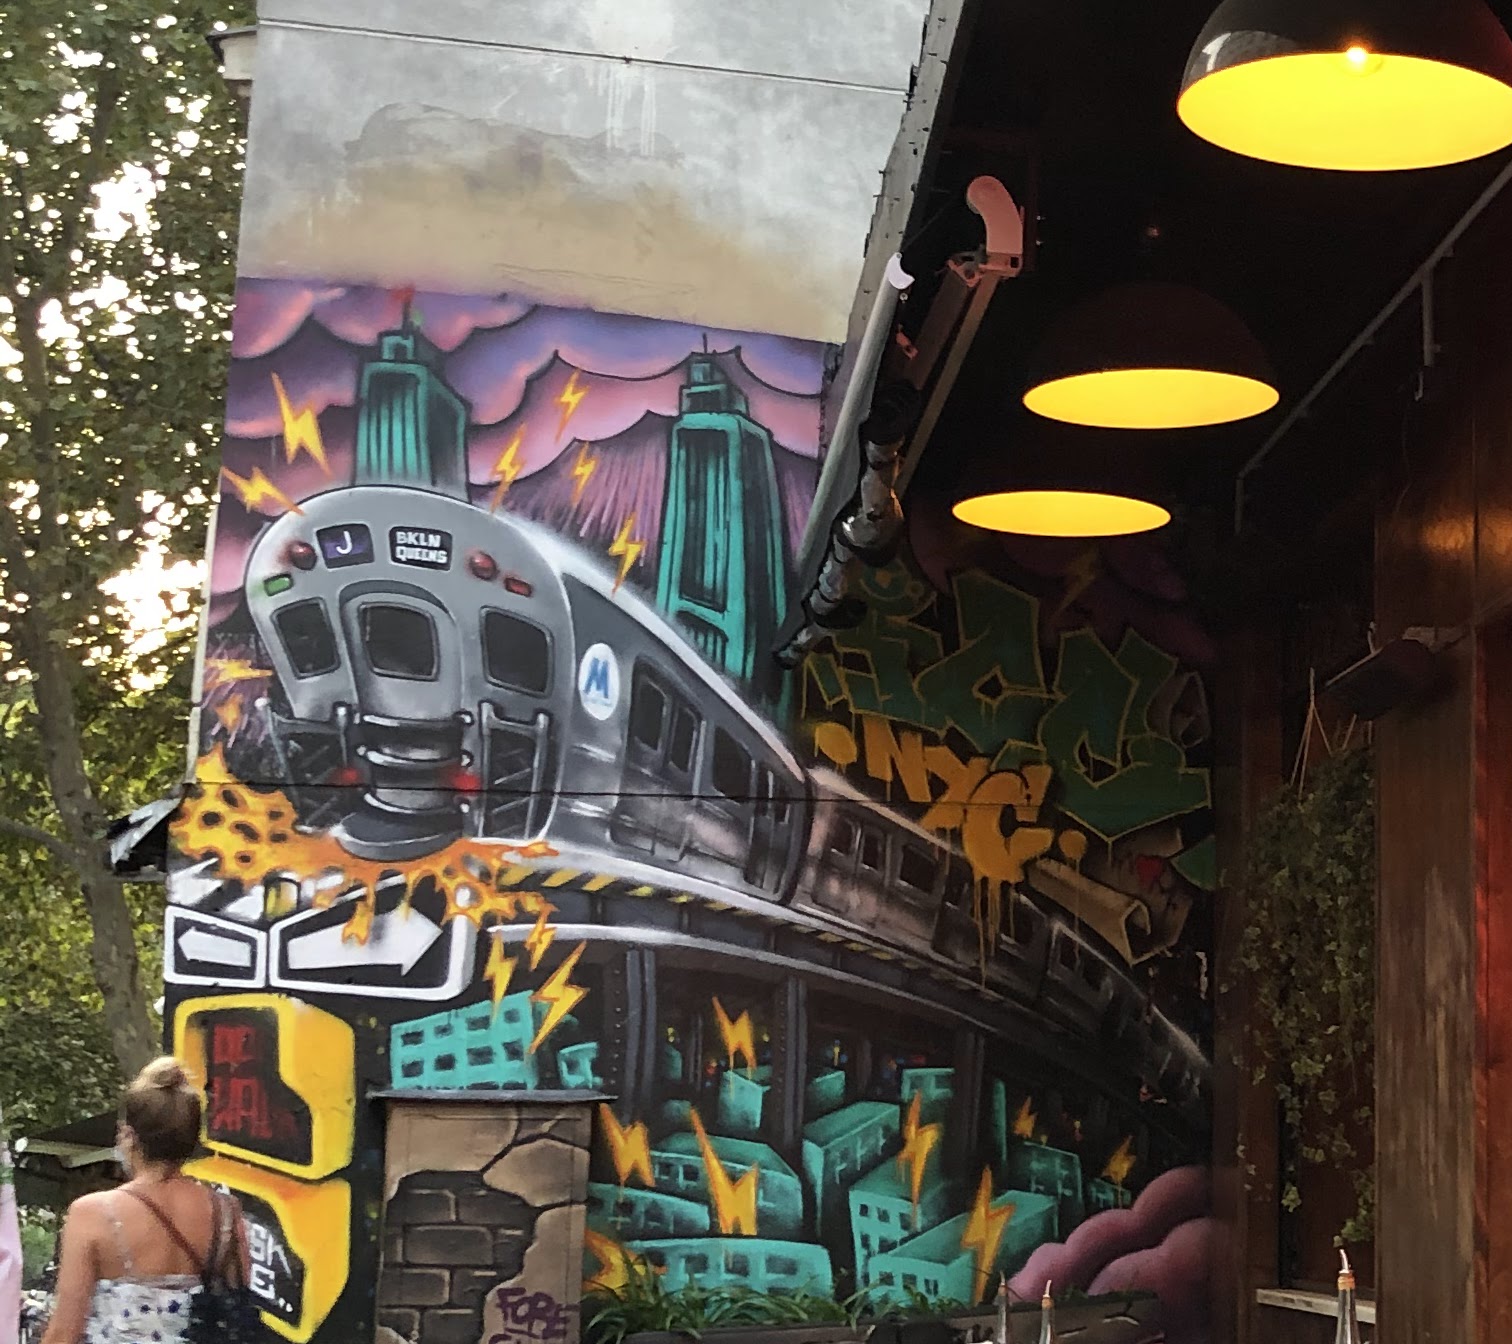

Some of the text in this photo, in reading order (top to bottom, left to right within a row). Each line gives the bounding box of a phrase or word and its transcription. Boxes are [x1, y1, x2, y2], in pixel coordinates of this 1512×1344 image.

[335, 530, 353, 555] J
[395, 530, 442, 549] BKLN
[395, 545, 448, 564] QUEENS
[583, 656, 610, 700] M
